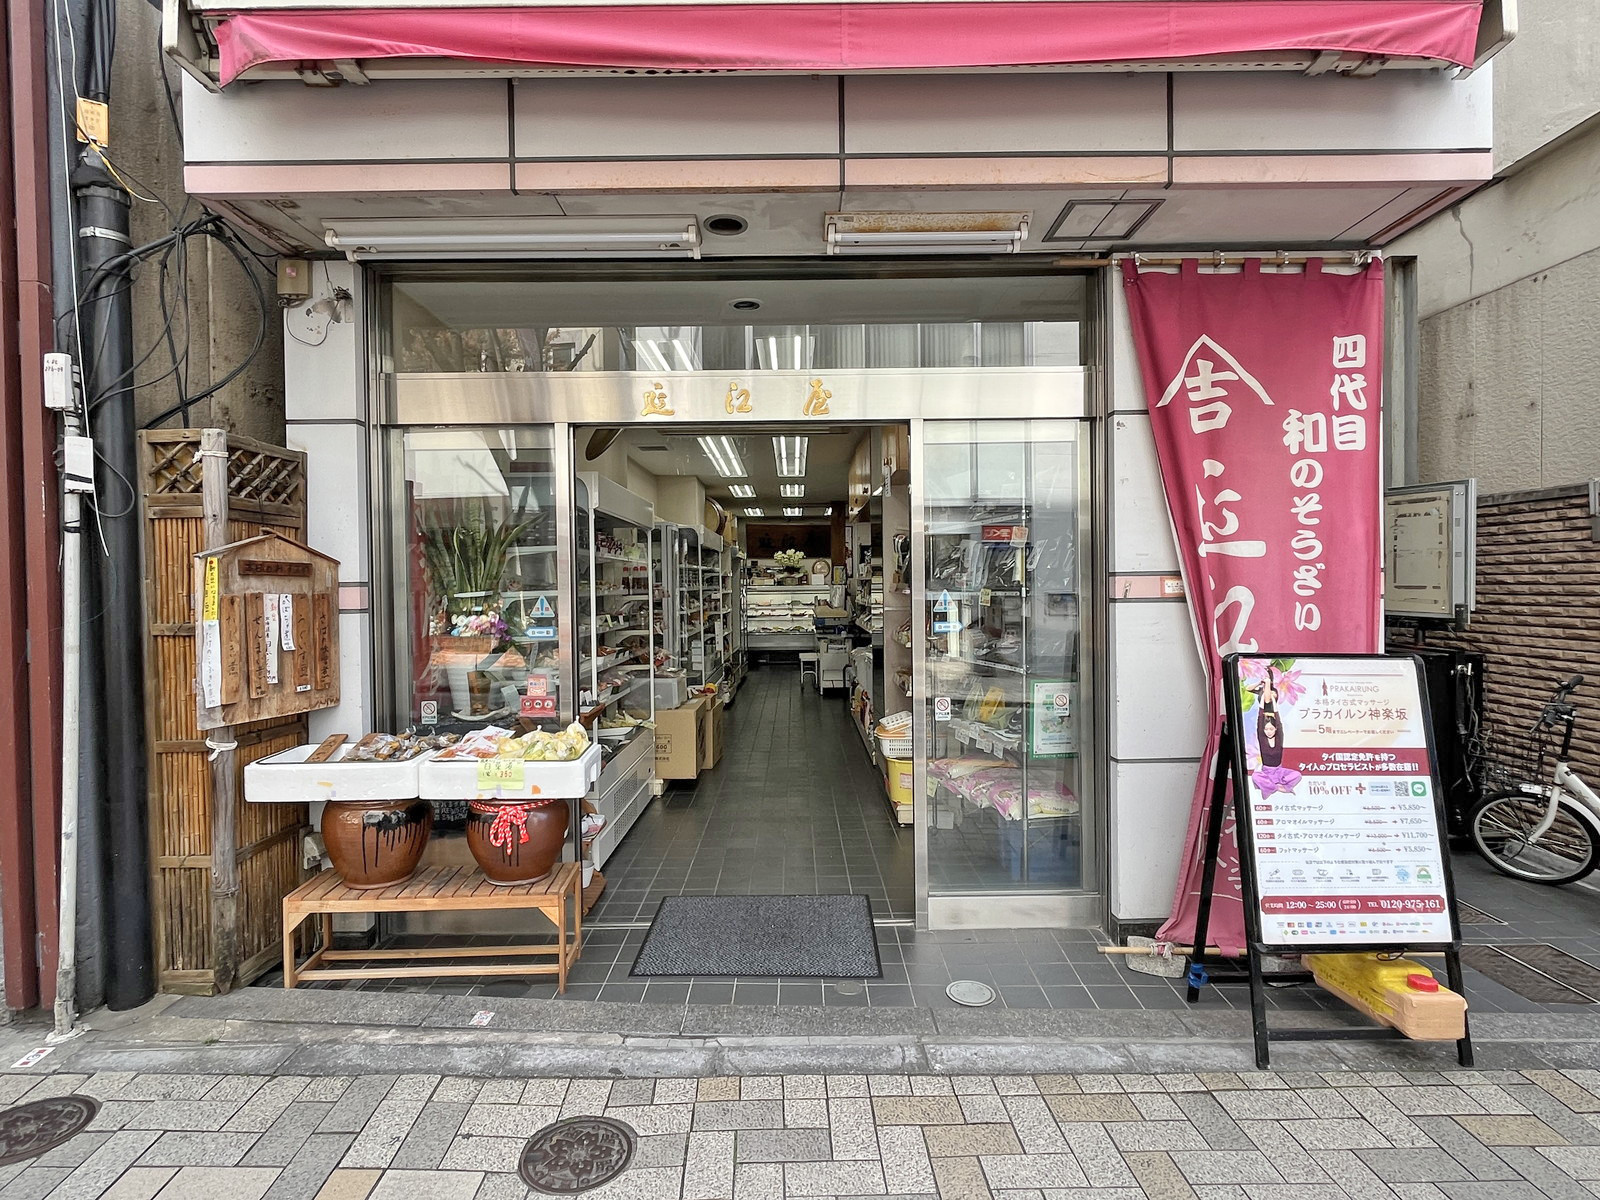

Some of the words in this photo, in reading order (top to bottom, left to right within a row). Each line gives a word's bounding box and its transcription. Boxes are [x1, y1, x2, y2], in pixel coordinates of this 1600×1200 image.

[1330, 334, 1367, 451] 四代目
[1282, 408, 1328, 631] 和のそうざい
[1322, 752, 1396, 762] タイ国認定免許を持つ
[1308, 786, 1330, 795] 10%
[1331, 786, 1352, 794] OFF
